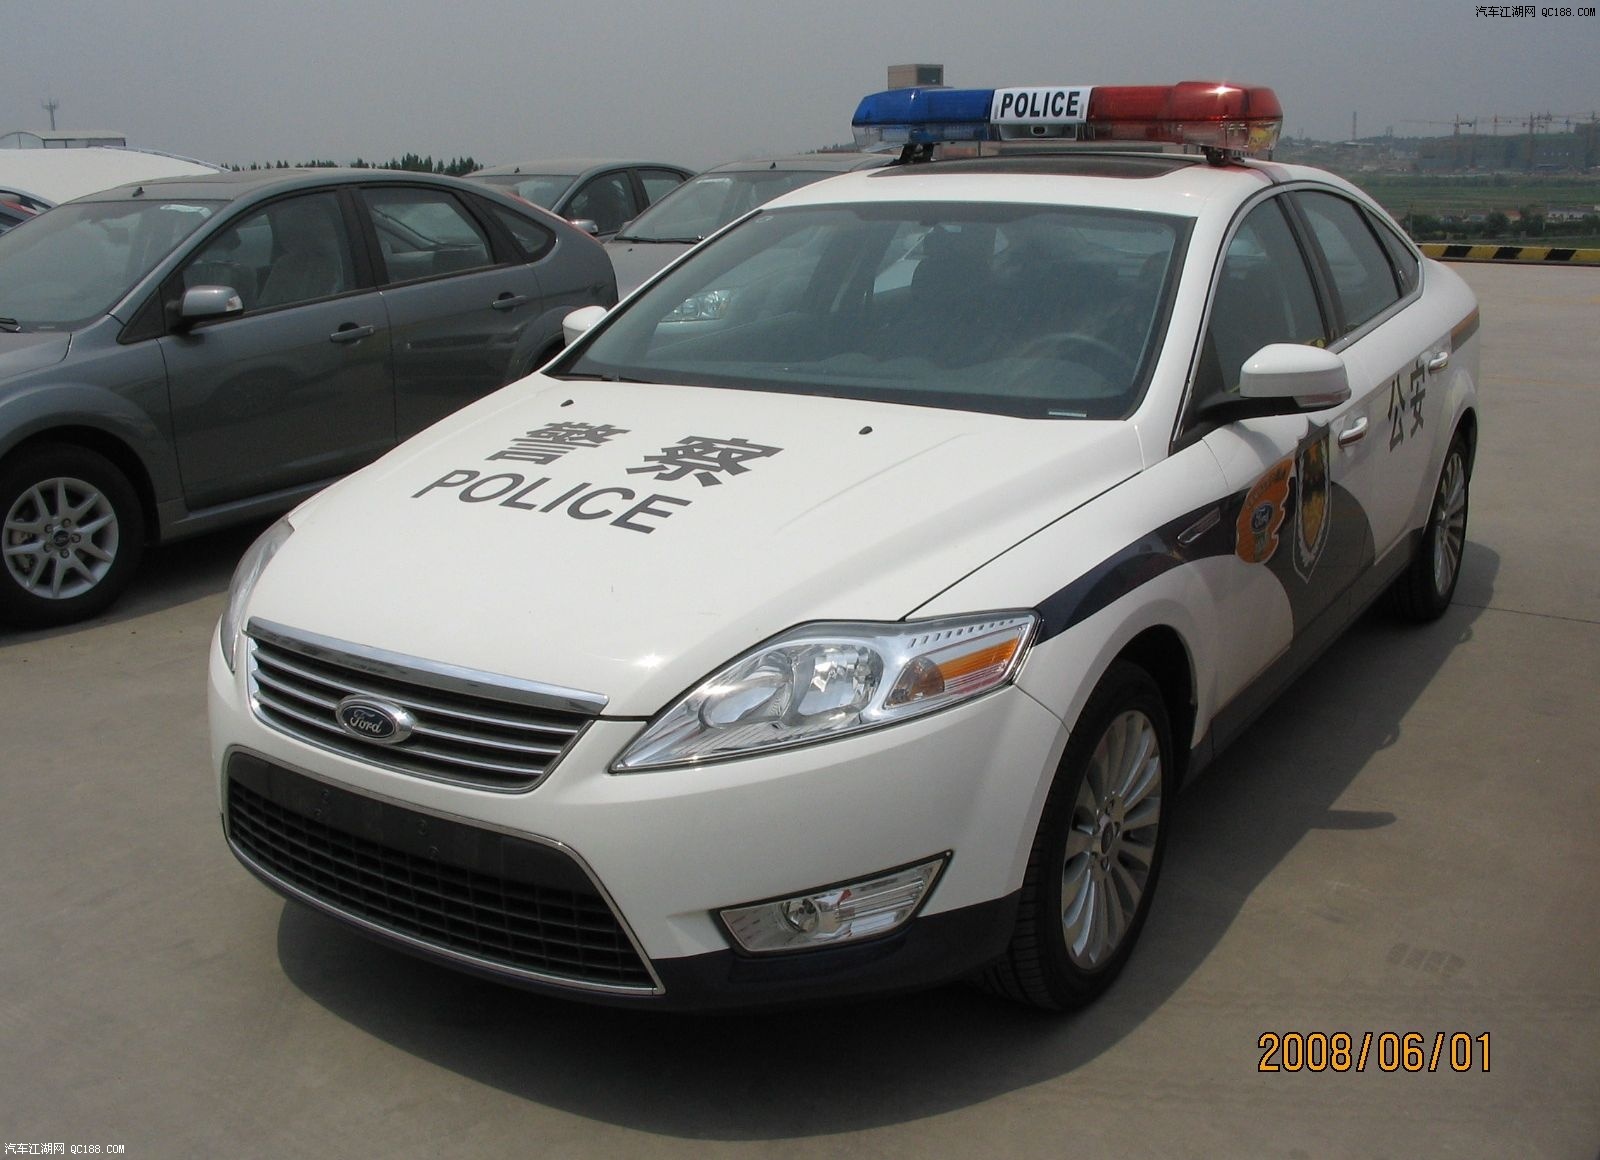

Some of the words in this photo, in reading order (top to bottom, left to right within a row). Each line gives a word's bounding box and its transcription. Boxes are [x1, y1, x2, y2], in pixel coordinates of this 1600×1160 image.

[1000, 91, 1081, 119] POLICE
[1387, 359, 1426, 453] 公安
[484, 421, 785, 488] 警察
[410, 469, 693, 535] POLICE
[350, 708, 382, 733] Ford
